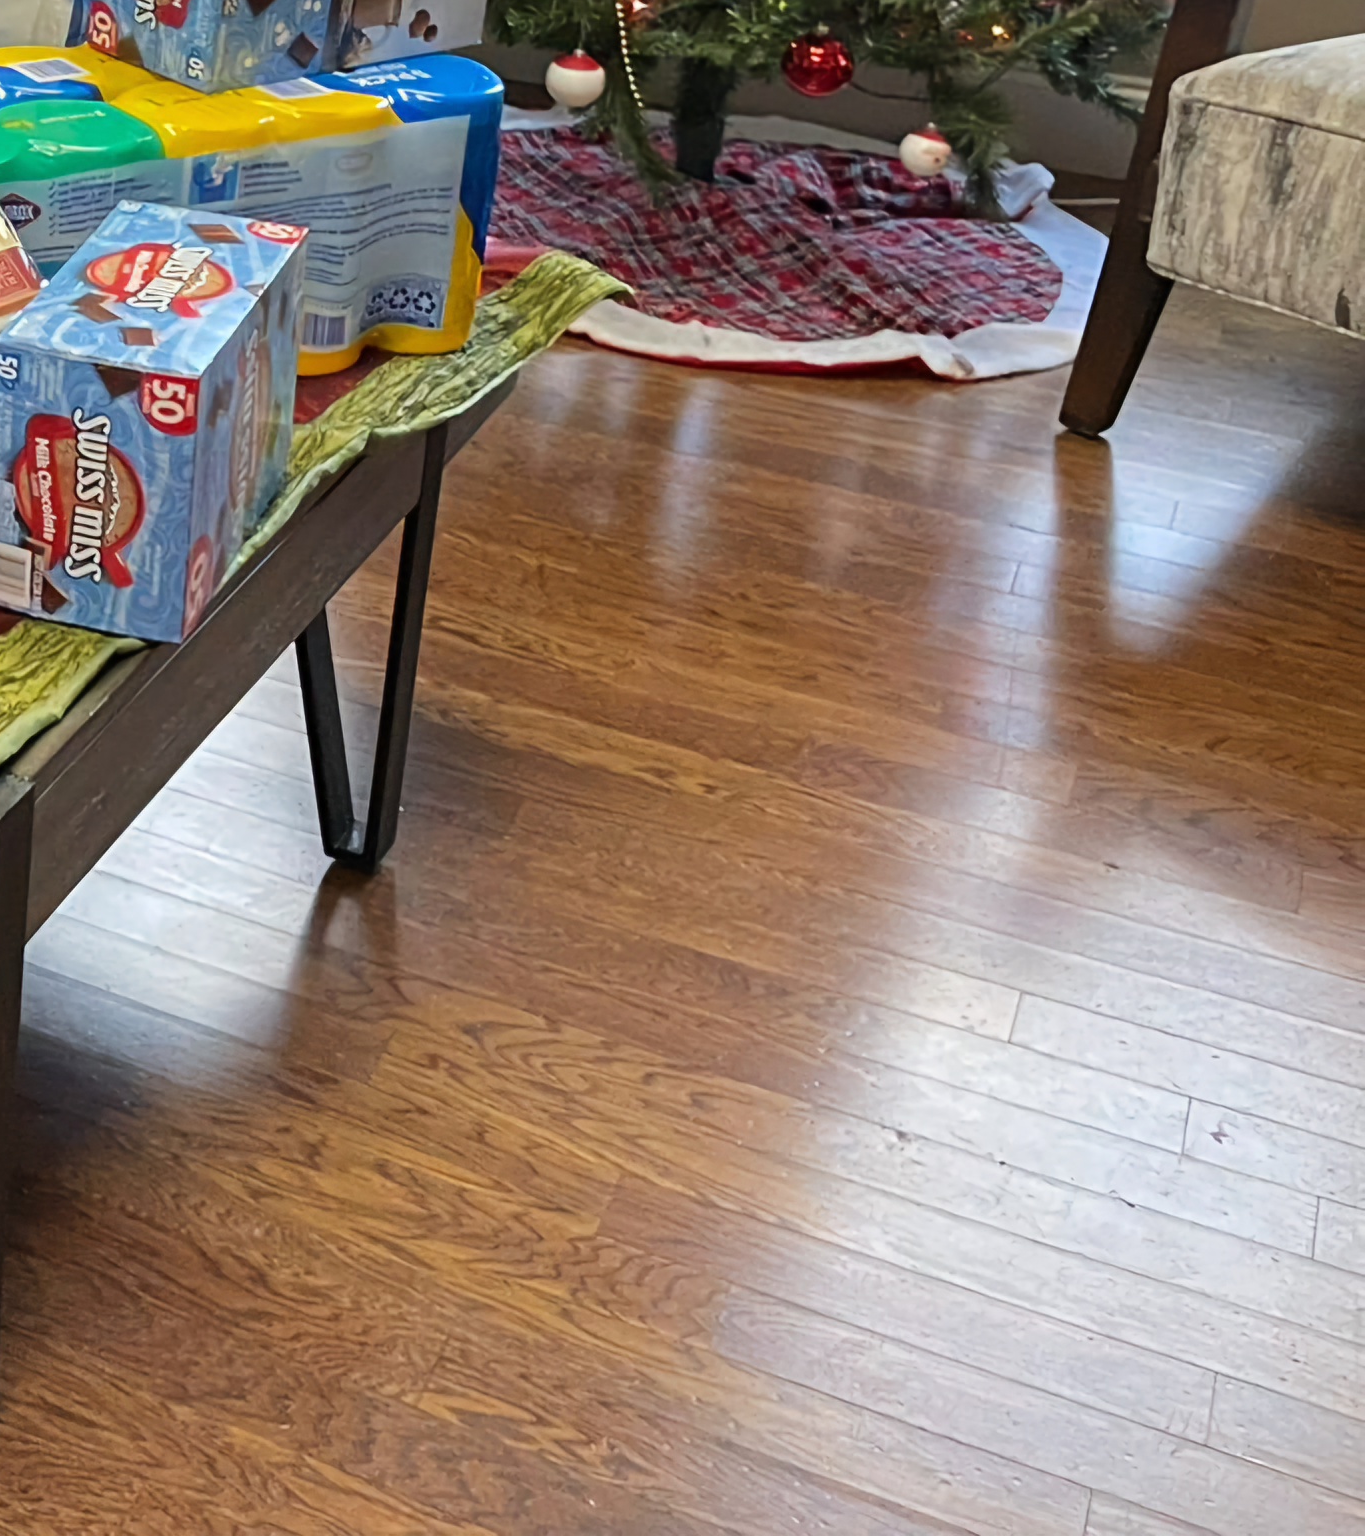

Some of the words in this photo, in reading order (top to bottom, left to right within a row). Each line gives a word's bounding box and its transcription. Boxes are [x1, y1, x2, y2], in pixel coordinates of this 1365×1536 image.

[93, 10, 114, 50] 50
[186, 57, 204, 81] 50
[150, 379, 186, 425] 50
[35, 437, 50, 469] Milk
[37, 470, 55, 542] Chocolate
